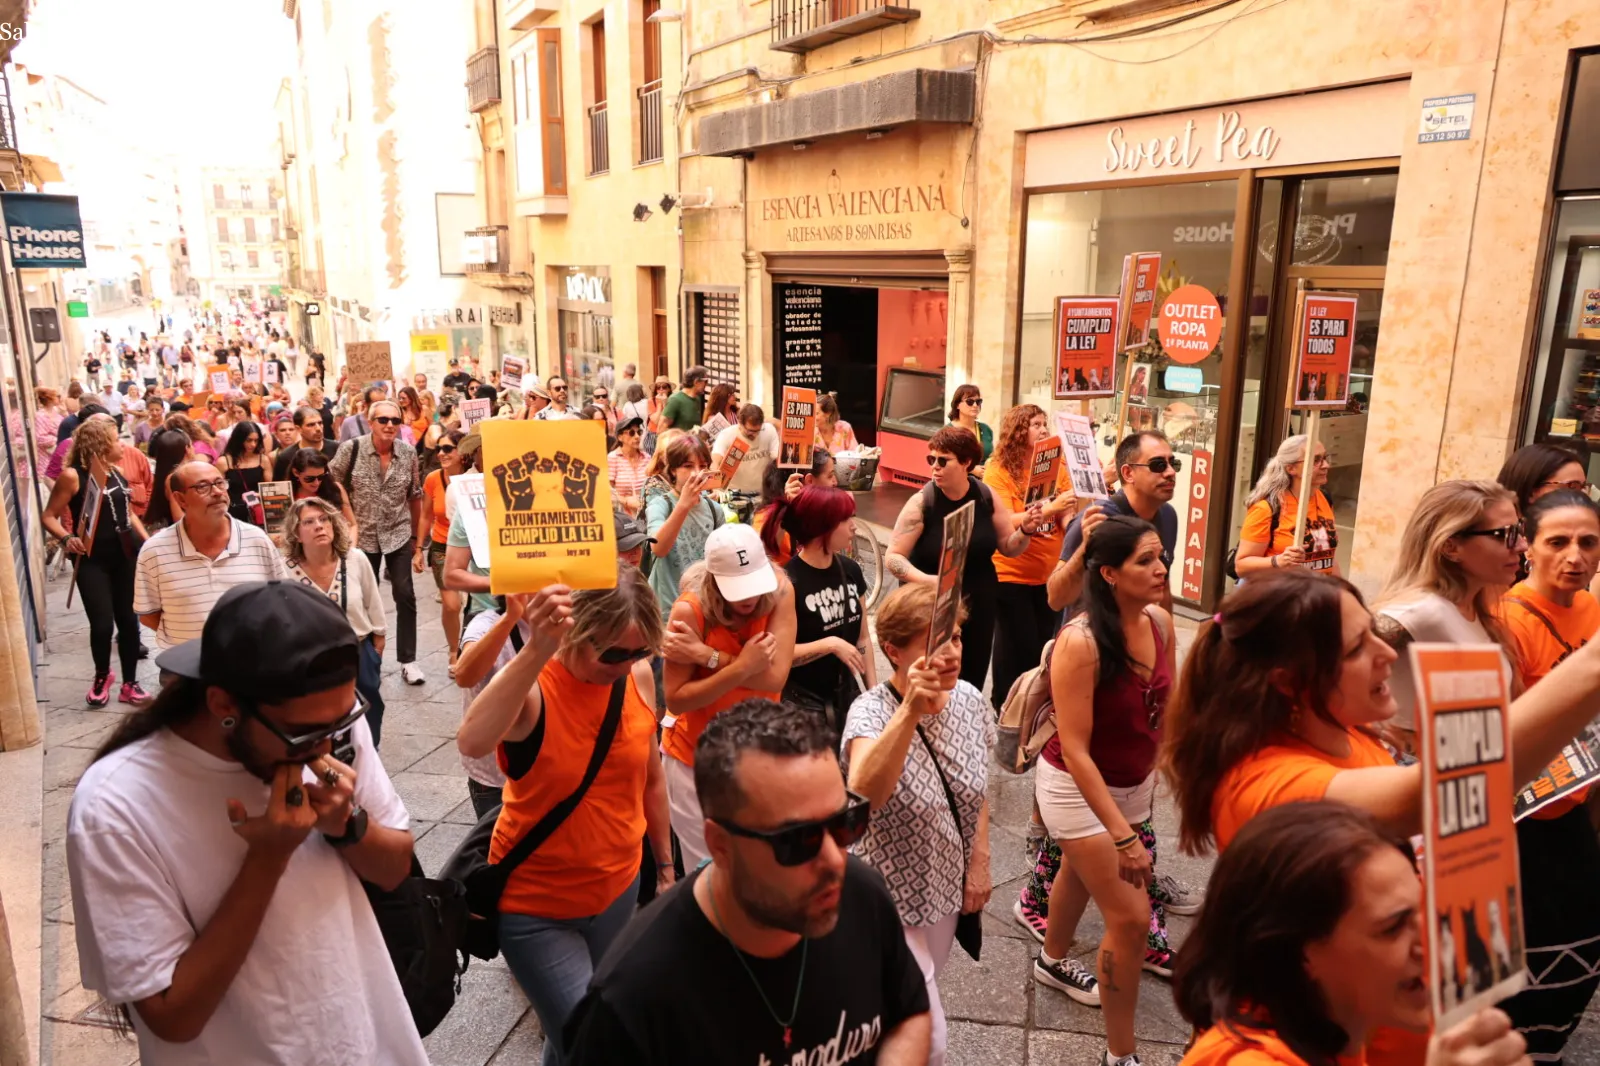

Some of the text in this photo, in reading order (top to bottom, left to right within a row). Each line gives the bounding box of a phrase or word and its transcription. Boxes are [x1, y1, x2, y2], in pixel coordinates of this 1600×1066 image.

[1102, 110, 1281, 172] Sweet Pea
[1420, 130, 1467, 142] 923 12 50 97
[762, 184, 946, 221] ESENCIA VALENCIANA
[9, 226, 81, 242] Phone
[786, 224, 843, 242] ARTESANOS
[855, 222, 912, 240] SONRISAS
[12, 243, 82, 259] House
[785, 287, 822, 296] esencia
[785, 296, 822, 304] valenciana
[420, 308, 482, 324] TERRA
[1165, 303, 1217, 320] OUTLET
[1310, 307, 1327, 316] LA LEY
[1067, 319, 1111, 333] CUMPLID
[1170, 321, 1207, 337] ROPA
[1309, 319, 1345, 335] ES PARA
[785, 339, 822, 347] granizados
[1066, 336, 1096, 350] LA LEY
[1176, 338, 1209, 350] PLANTA
[1308, 338, 1335, 354] TODOS
[786, 376, 822, 384] alboraya
[786, 402, 812, 416] ES PARA
[785, 417, 805, 430] TODOS
[1035, 447, 1059, 463] ES PARA
[1034, 461, 1051, 475] TODOS
[1187, 457, 1207, 550] ROPA
[505, 511, 596, 527] AYUNTAMIENTOS
[501, 525, 602, 545] CUMPLID LA LEY
[736, 550, 750, 567] E
[1185, 558, 1201, 575] 1ª
[1547, 752, 1577, 788] PUE
[1532, 777, 1556, 798] NO
